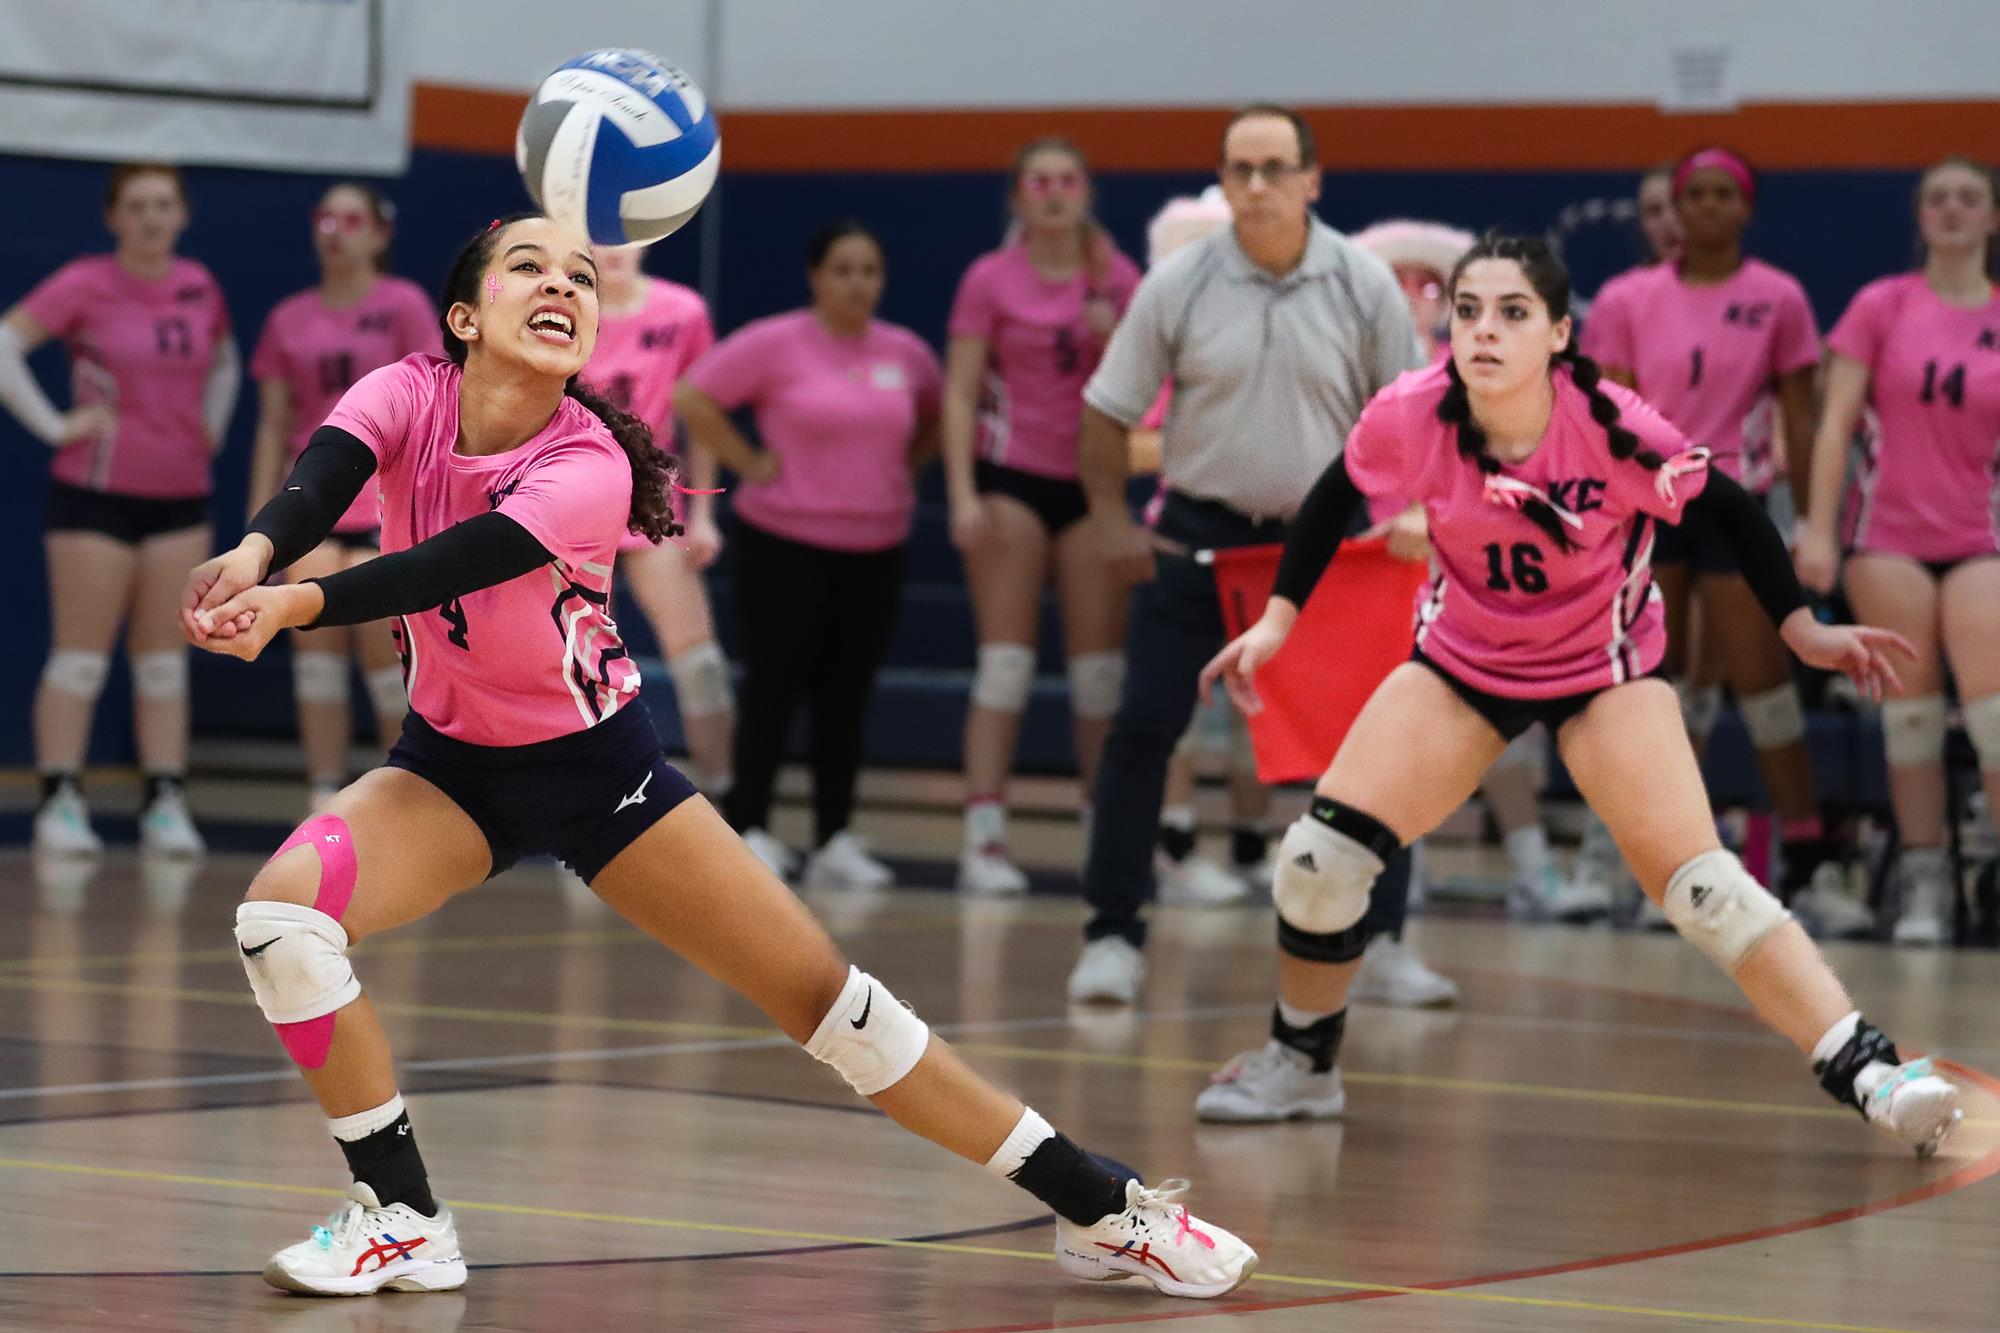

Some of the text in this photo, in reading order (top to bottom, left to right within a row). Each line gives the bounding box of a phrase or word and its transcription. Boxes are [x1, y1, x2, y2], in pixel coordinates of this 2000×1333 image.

[1921, 359, 1966, 406] 14
[1547, 477, 1606, 512] KC
[1484, 542, 1548, 592] 16
[325, 833, 341, 843] KT
